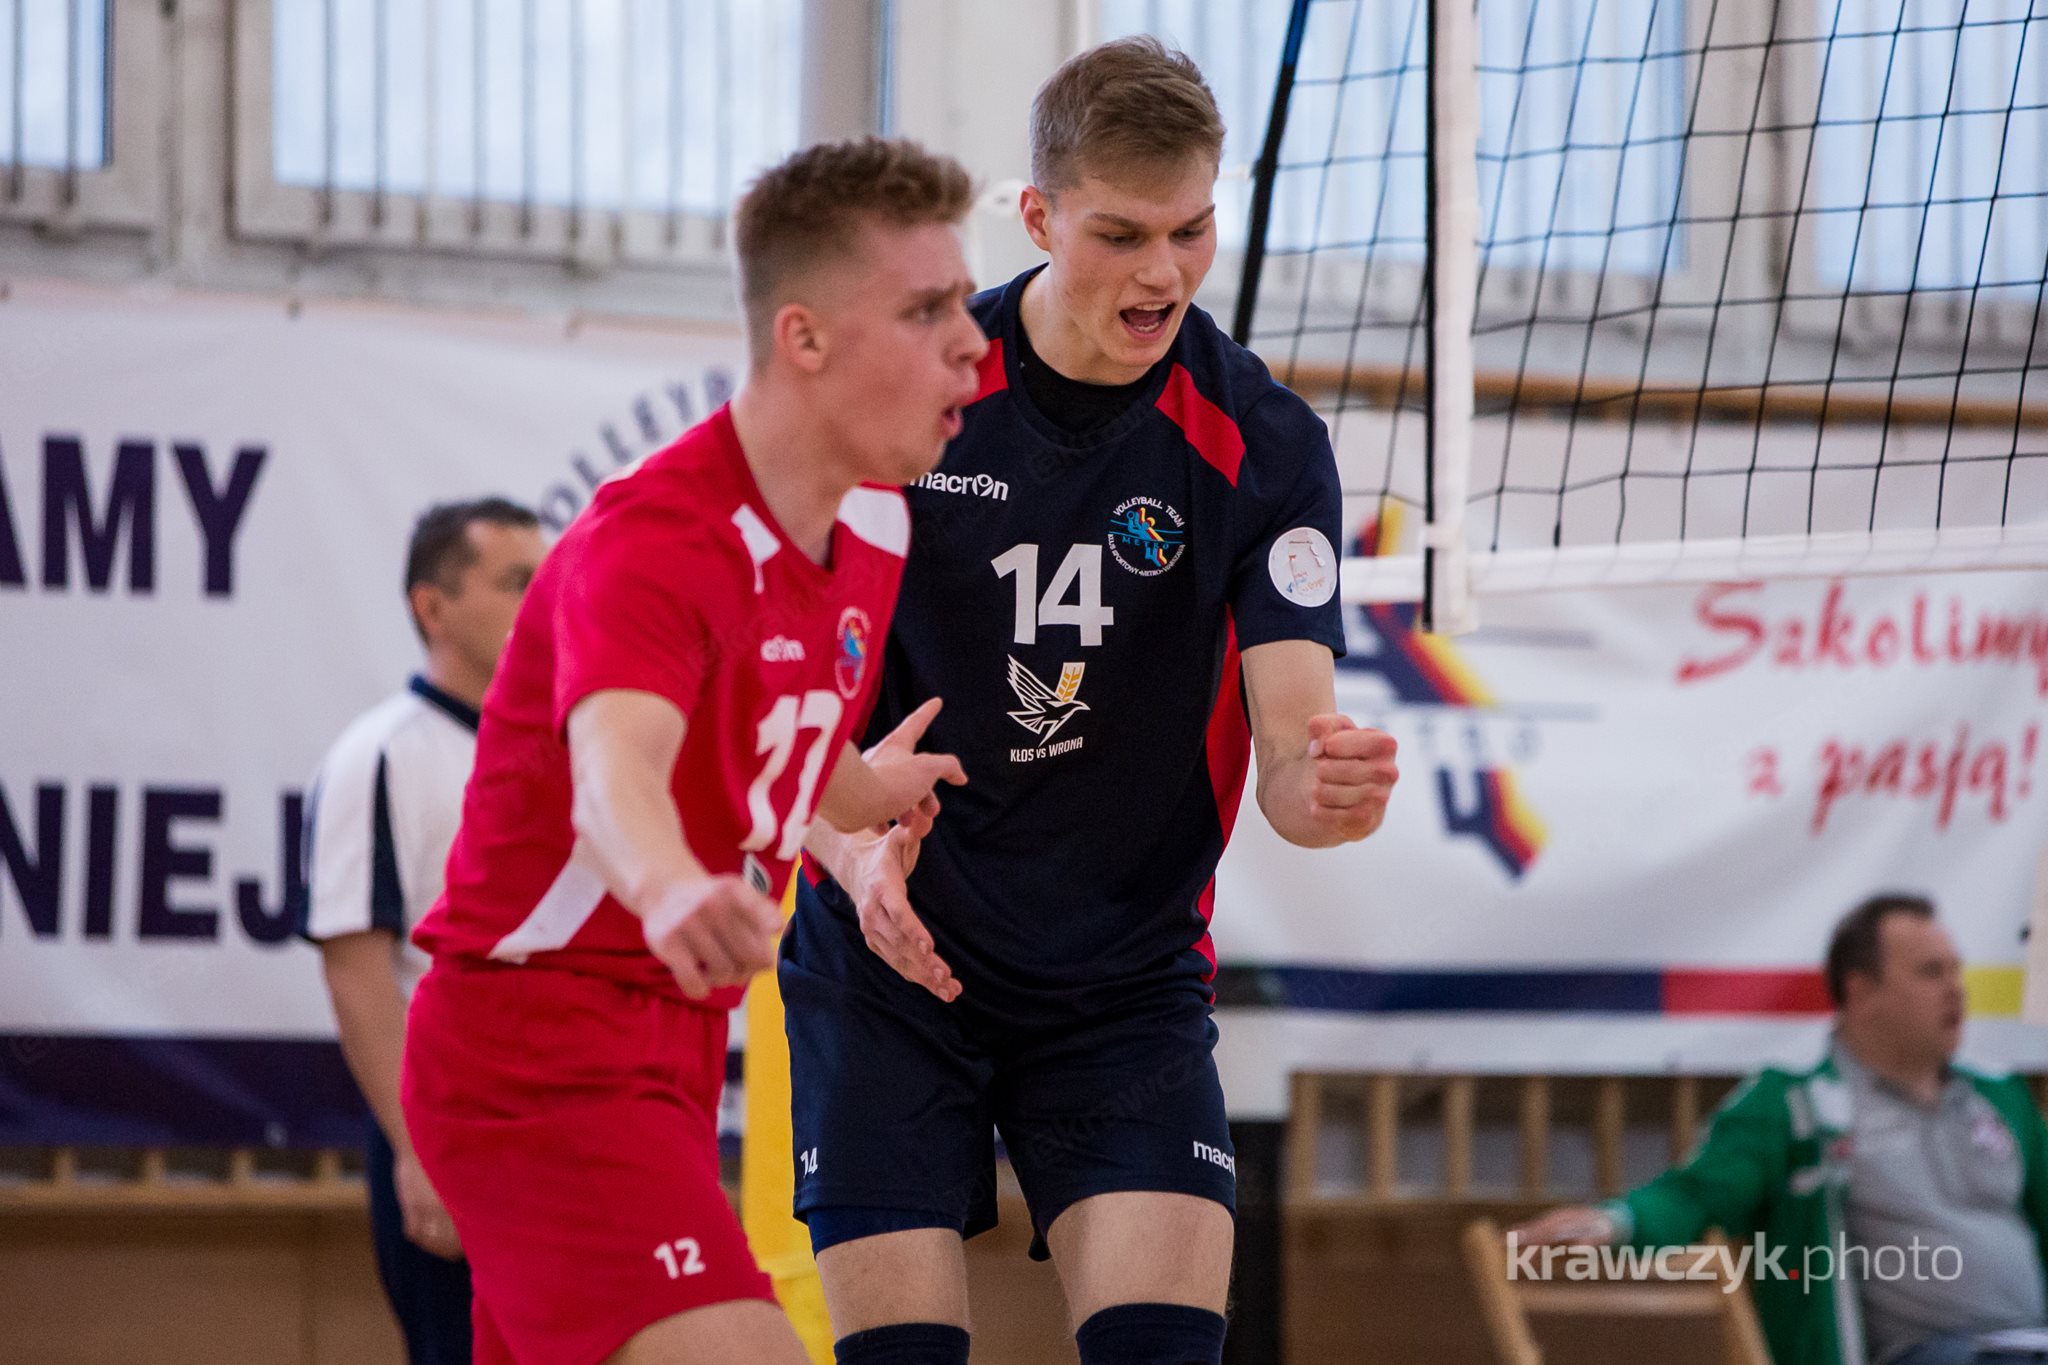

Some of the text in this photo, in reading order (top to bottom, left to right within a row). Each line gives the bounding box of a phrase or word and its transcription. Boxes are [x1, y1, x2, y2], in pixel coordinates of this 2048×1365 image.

[1112, 496, 1186, 528] VOLLEYBALL TEAM
[991, 543, 1115, 647] 14
[1010, 748, 1034, 762] KŁOS
[1048, 736, 1084, 757] WRONA
[800, 1147, 818, 1179] 14
[653, 1236, 707, 1279] 12
